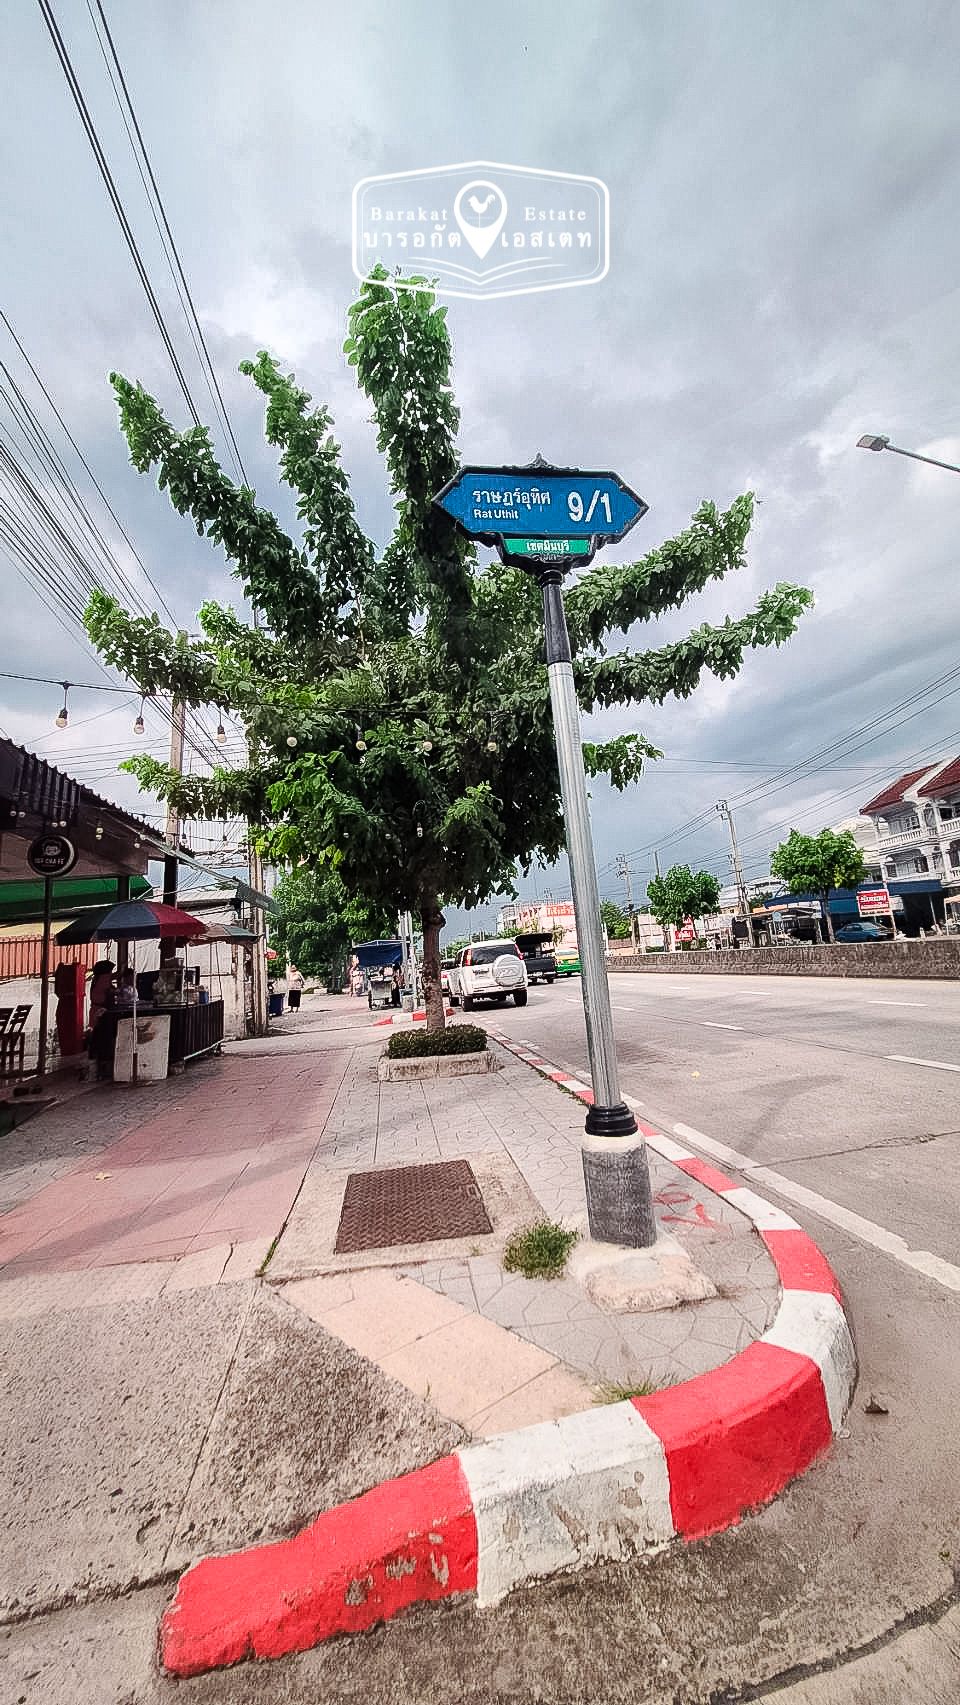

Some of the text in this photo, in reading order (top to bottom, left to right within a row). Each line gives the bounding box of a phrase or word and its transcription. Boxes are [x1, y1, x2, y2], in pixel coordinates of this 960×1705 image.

[472, 487, 551, 510] ราษฎร์อุทิศ
[567, 489, 612, 523] 9/1
[473, 509, 519, 520] Rat Uthit
